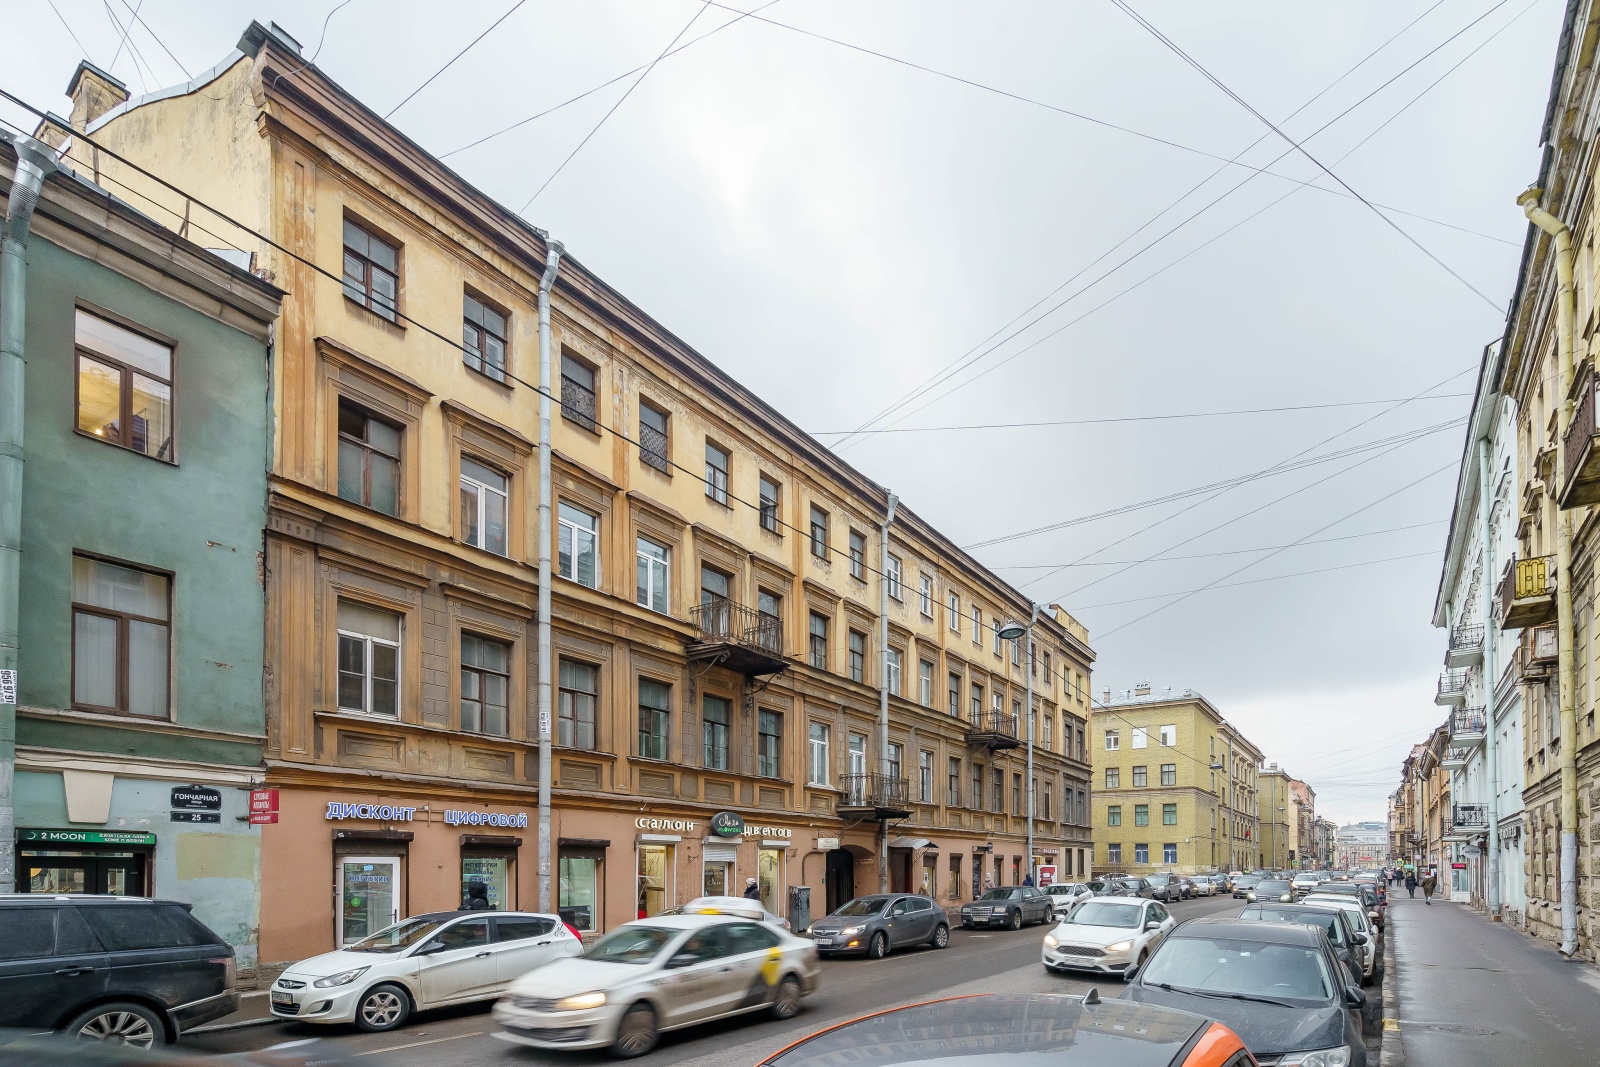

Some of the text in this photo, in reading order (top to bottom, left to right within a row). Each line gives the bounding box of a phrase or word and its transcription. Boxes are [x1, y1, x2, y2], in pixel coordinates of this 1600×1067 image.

[1, 670, 12, 685] 956
[3, 685, 14, 694] 97
[5, 695, 14, 703] 91
[174, 793, 218, 802] ГОНЧАРНАЯ
[191, 813, 201, 821] 25
[326, 802, 528, 828] ДИСКОНТ ЦИФРОВОЙ
[635, 817, 792, 838] салон цветов
[50, 832, 86, 840] MOON
